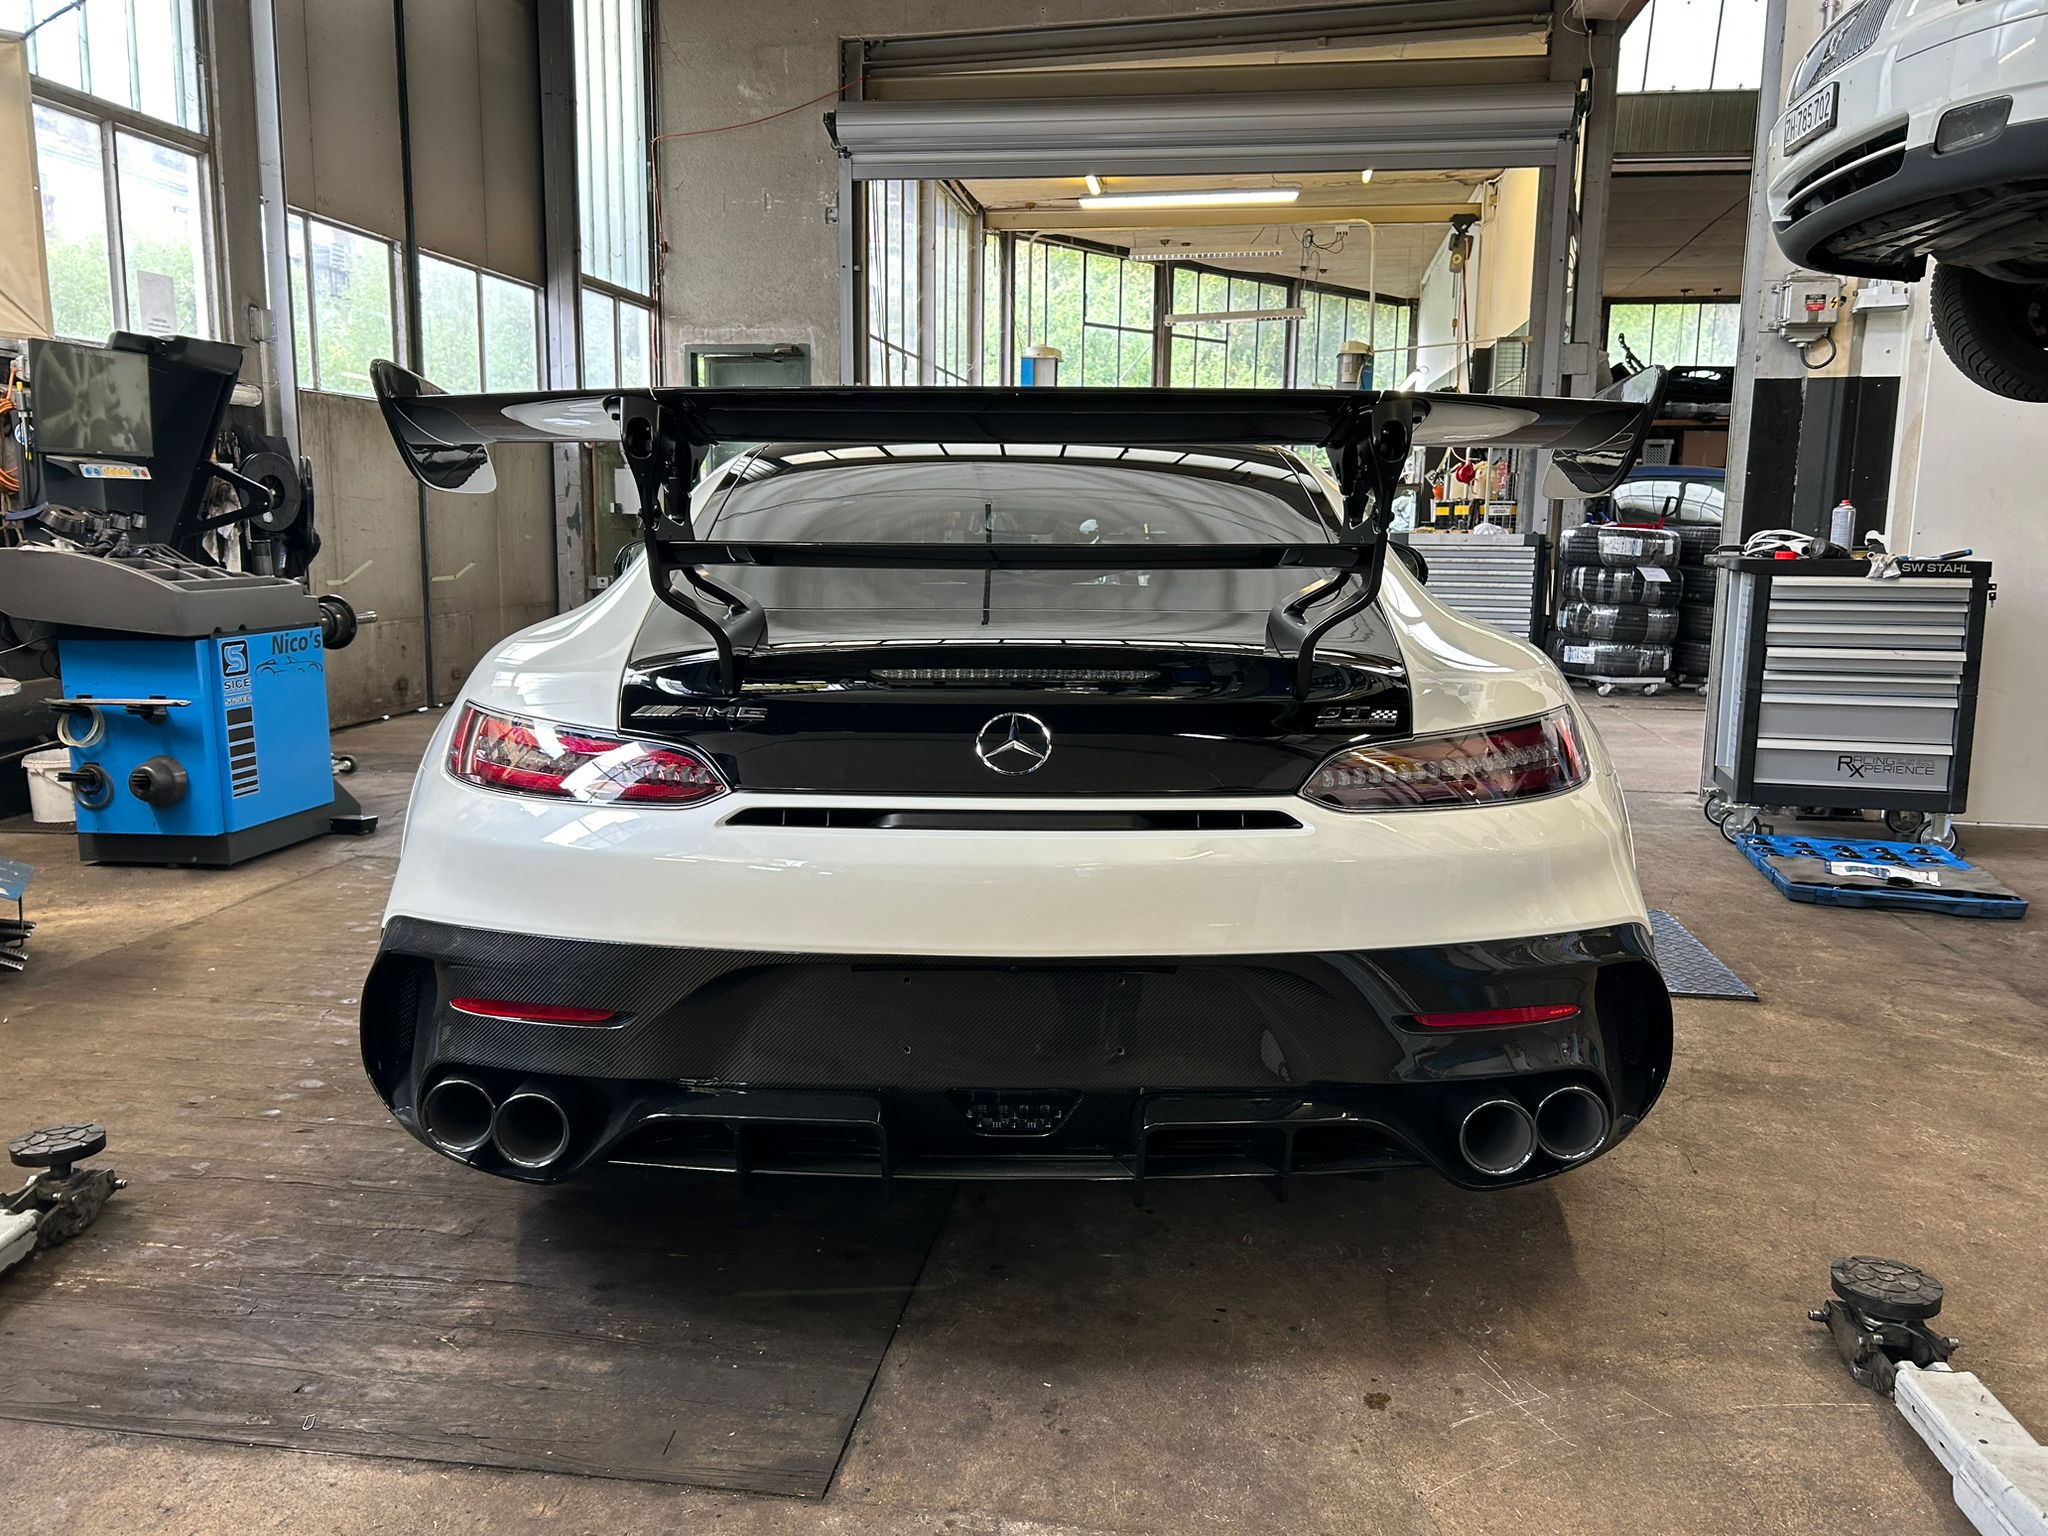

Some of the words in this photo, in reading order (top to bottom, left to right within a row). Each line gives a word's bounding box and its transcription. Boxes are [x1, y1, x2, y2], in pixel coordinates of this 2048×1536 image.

[1901, 563, 1925, 572] SW
[1926, 563, 1972, 574] STAHL
[271, 630, 322, 656] Nico's
[223, 679, 251, 691] SICE
[671, 705, 768, 718] AMG
